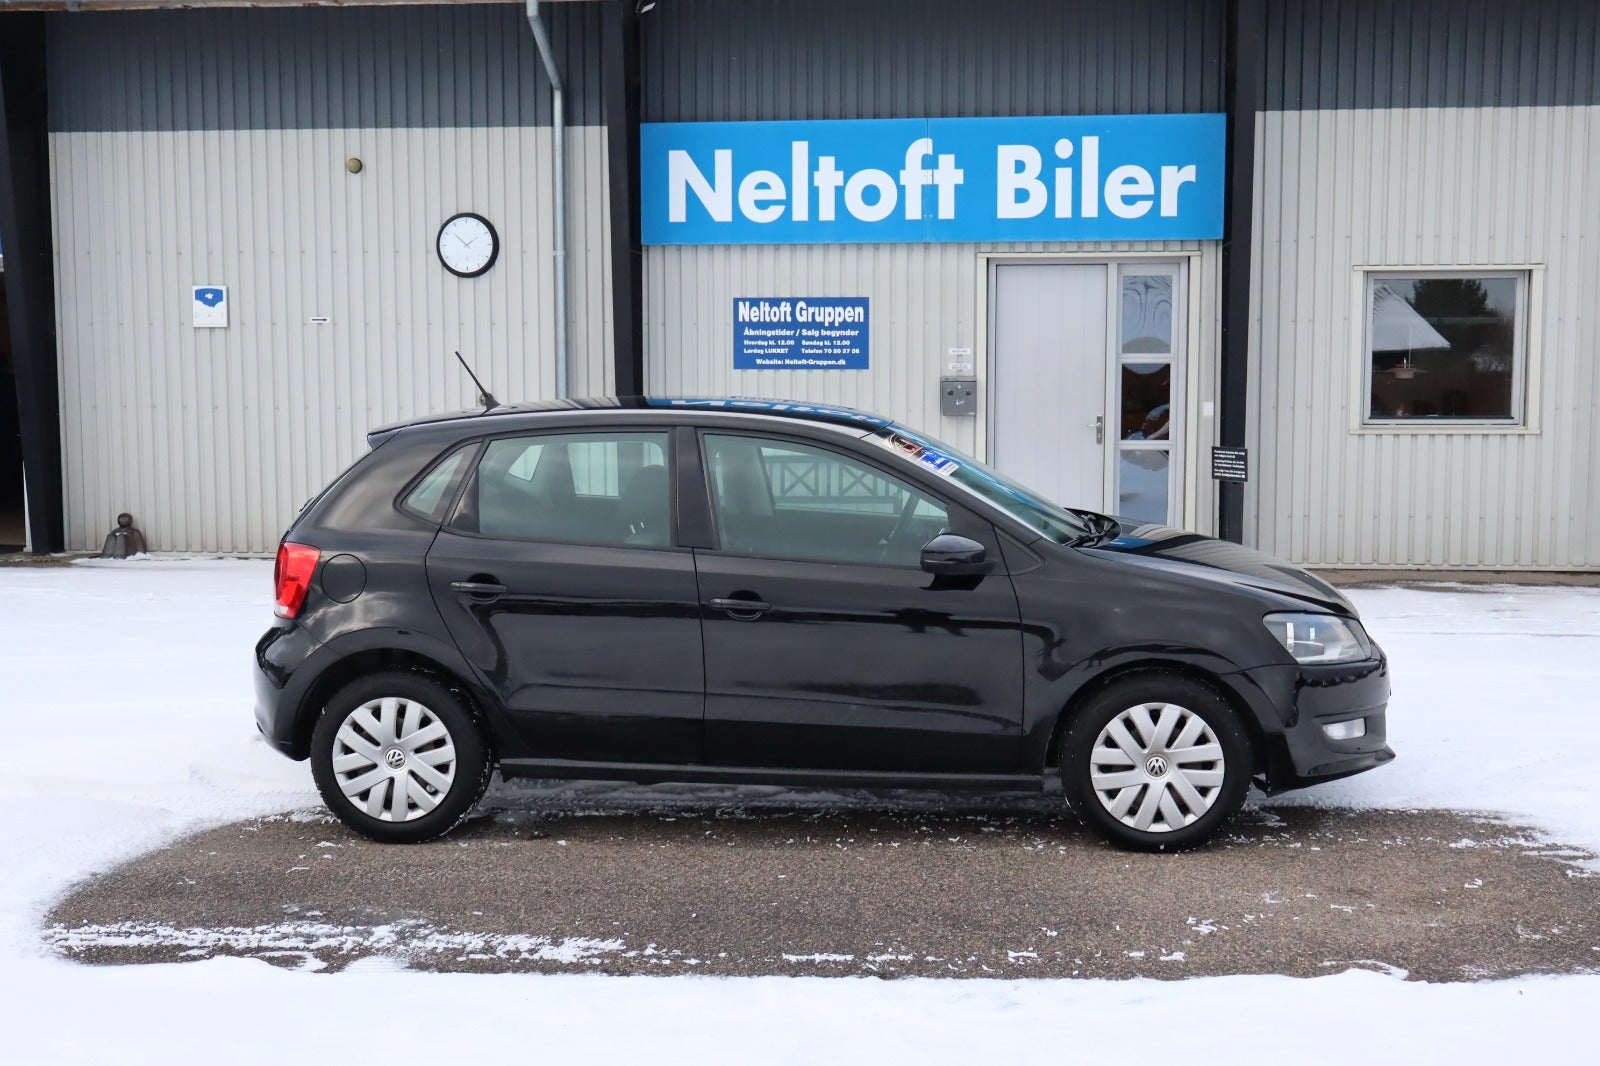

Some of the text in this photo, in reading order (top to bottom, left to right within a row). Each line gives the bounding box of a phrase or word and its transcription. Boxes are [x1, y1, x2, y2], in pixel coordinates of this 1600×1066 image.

[668, 135, 1196, 223] Neltoft Biler
[738, 301, 864, 326] Neltoft Gruppen
[743, 327, 795, 337] Åbningstider
[801, 329, 819, 337] Salg
[820, 329, 859, 337] begynder
[784, 358, 846, 366] Neltoft-Gruppen.dk
